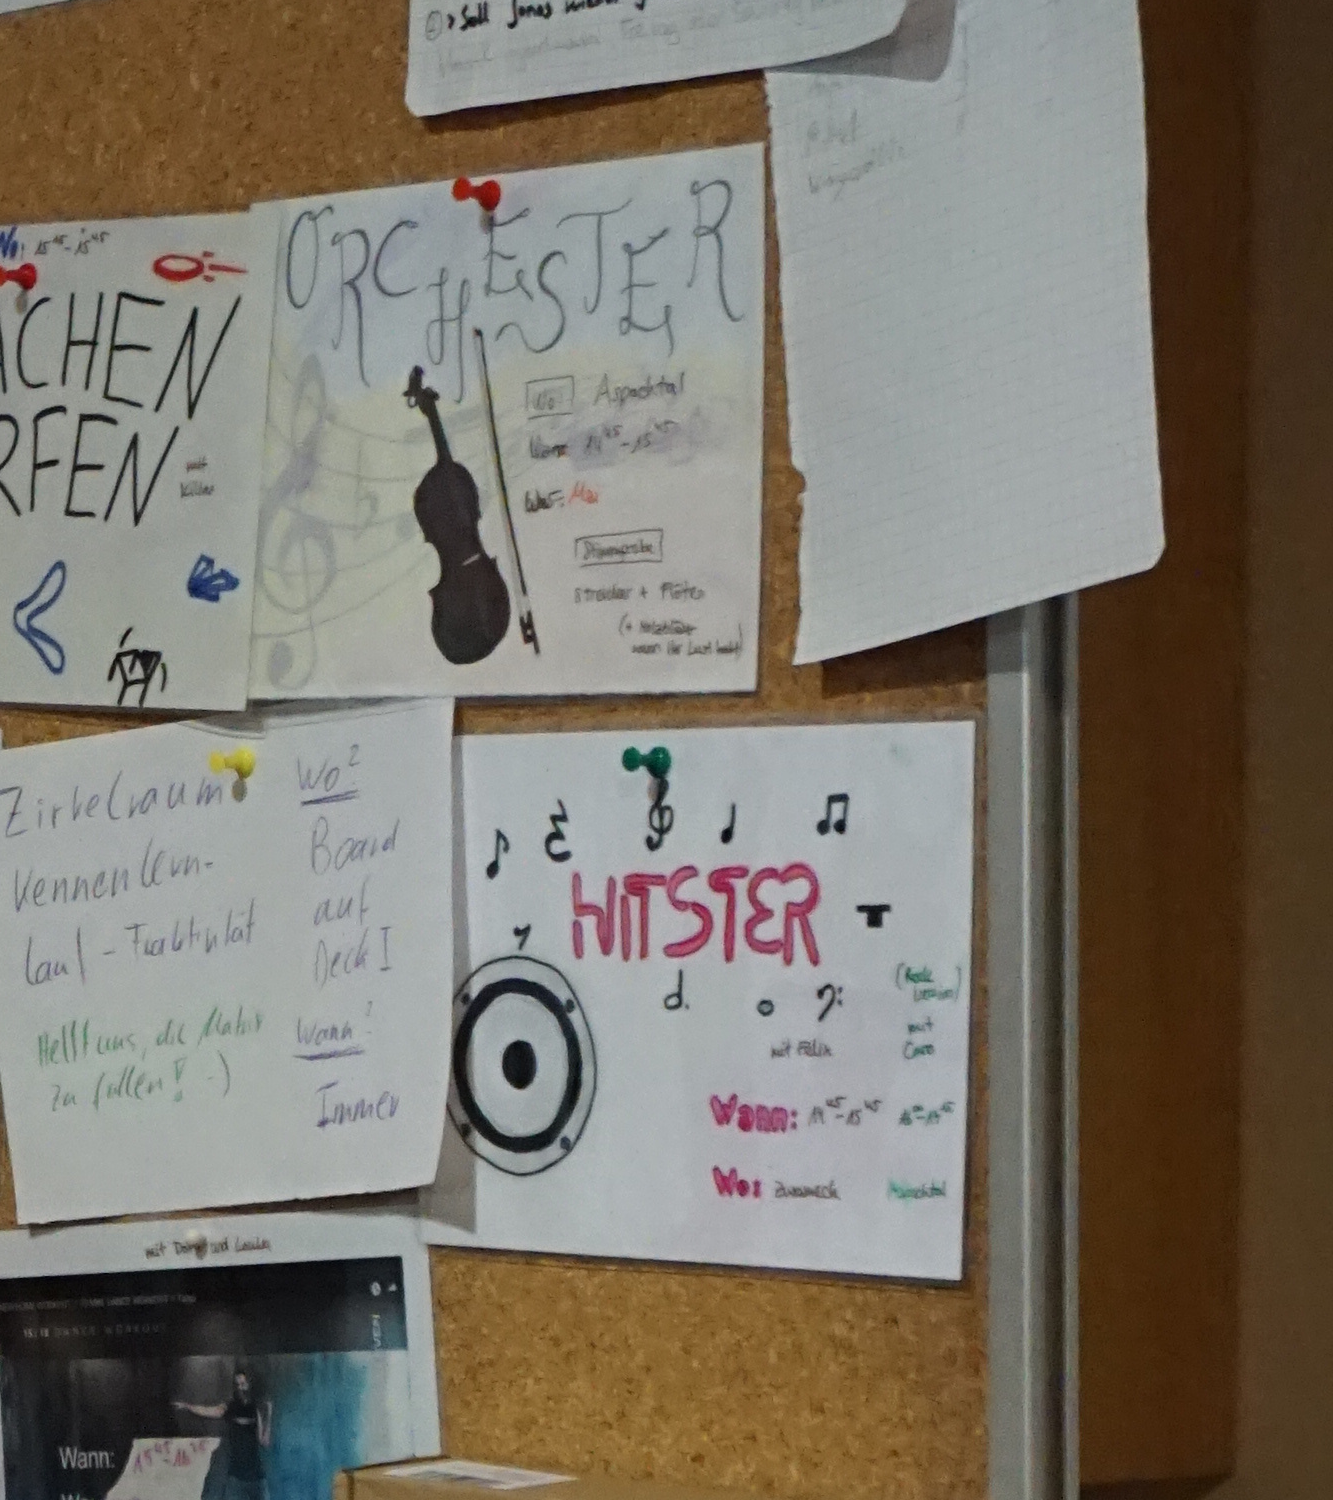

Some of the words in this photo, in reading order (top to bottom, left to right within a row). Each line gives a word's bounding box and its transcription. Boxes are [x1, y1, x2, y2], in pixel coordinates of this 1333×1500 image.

[286, 177, 745, 405] ORCHESTER
[313, 874, 372, 928] auf
[569, 860, 821, 968] HITSTER
[709, 1093, 800, 1133] Wann:
[712, 1165, 761, 1197] Wo:
[58, 1445, 117, 1470] Wann:
